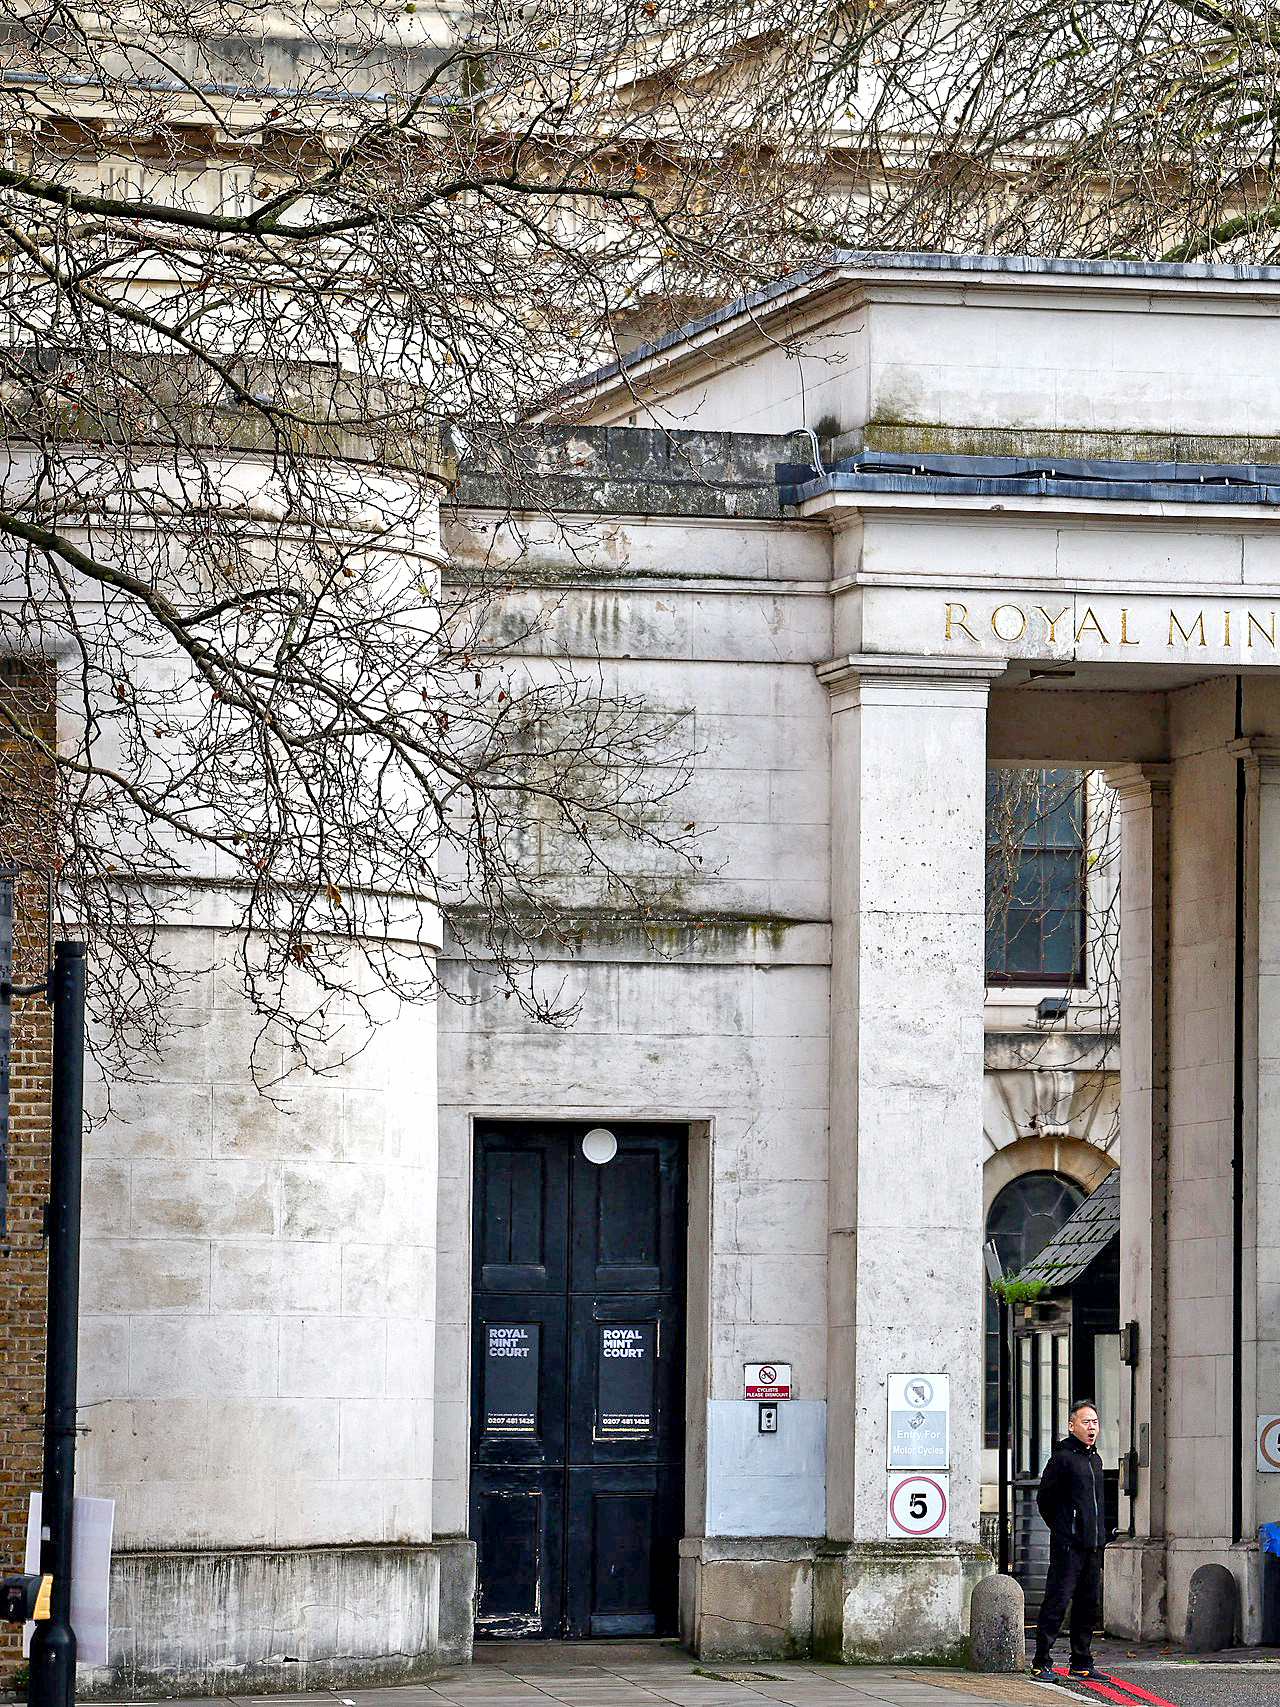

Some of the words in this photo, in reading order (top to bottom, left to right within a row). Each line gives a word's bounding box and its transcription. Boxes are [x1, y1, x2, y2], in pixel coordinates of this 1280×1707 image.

[945, 602, 1140, 645] ROYAL
[489, 1329, 528, 1338] ROYAL
[603, 1330, 643, 1339] ROYAL
[489, 1339, 519, 1347] MINT
[603, 1340, 633, 1348] MINT
[489, 1348, 530, 1357] COURT
[603, 1349, 644, 1358] COURT
[897, 1430, 922, 1440] Entry
[924, 1430, 940, 1439] For
[893, 1446, 916, 1454] Motor
[917, 1445, 944, 1456] Cycles
[909, 1493, 928, 1519] 5
